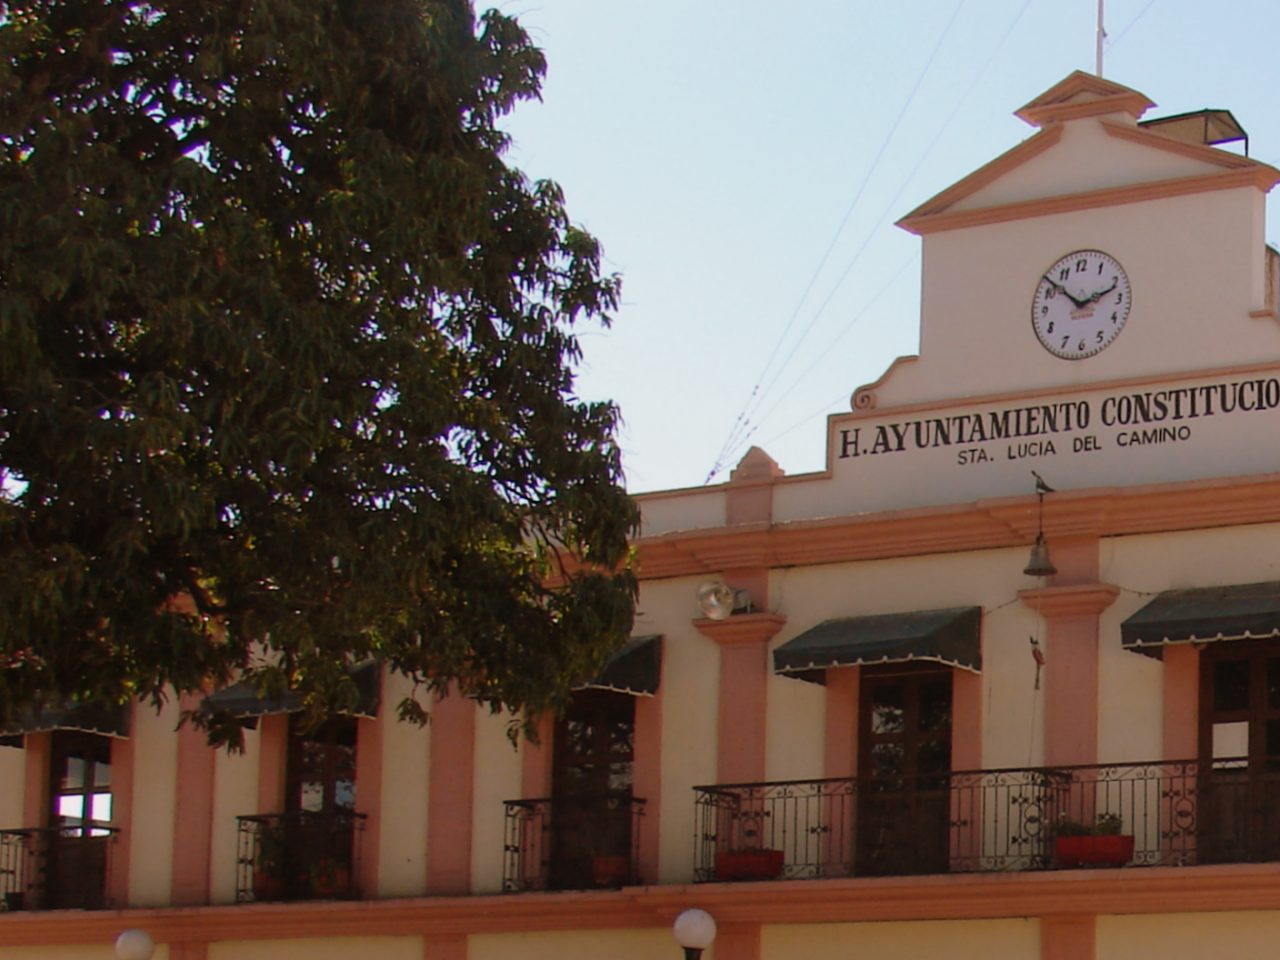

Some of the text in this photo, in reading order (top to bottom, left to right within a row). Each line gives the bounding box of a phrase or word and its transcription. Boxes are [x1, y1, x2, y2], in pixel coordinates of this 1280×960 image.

[1076, 260, 1087, 273] 12
[1098, 262, 1104, 275] 1
[1060, 268, 1070, 281] 11
[1045, 287, 1056, 300] 10
[1115, 293, 1122, 304] 3
[1042, 306, 1048, 317] 9
[1111, 312, 1117, 324] 4
[1047, 322, 1054, 333] 8
[1061, 335, 1070, 349] 7
[1096, 330, 1104, 343] 5
[1078, 339, 1085, 350] 6
[957, 425, 1191, 466] STA. LUCIA DEL CAMINO
